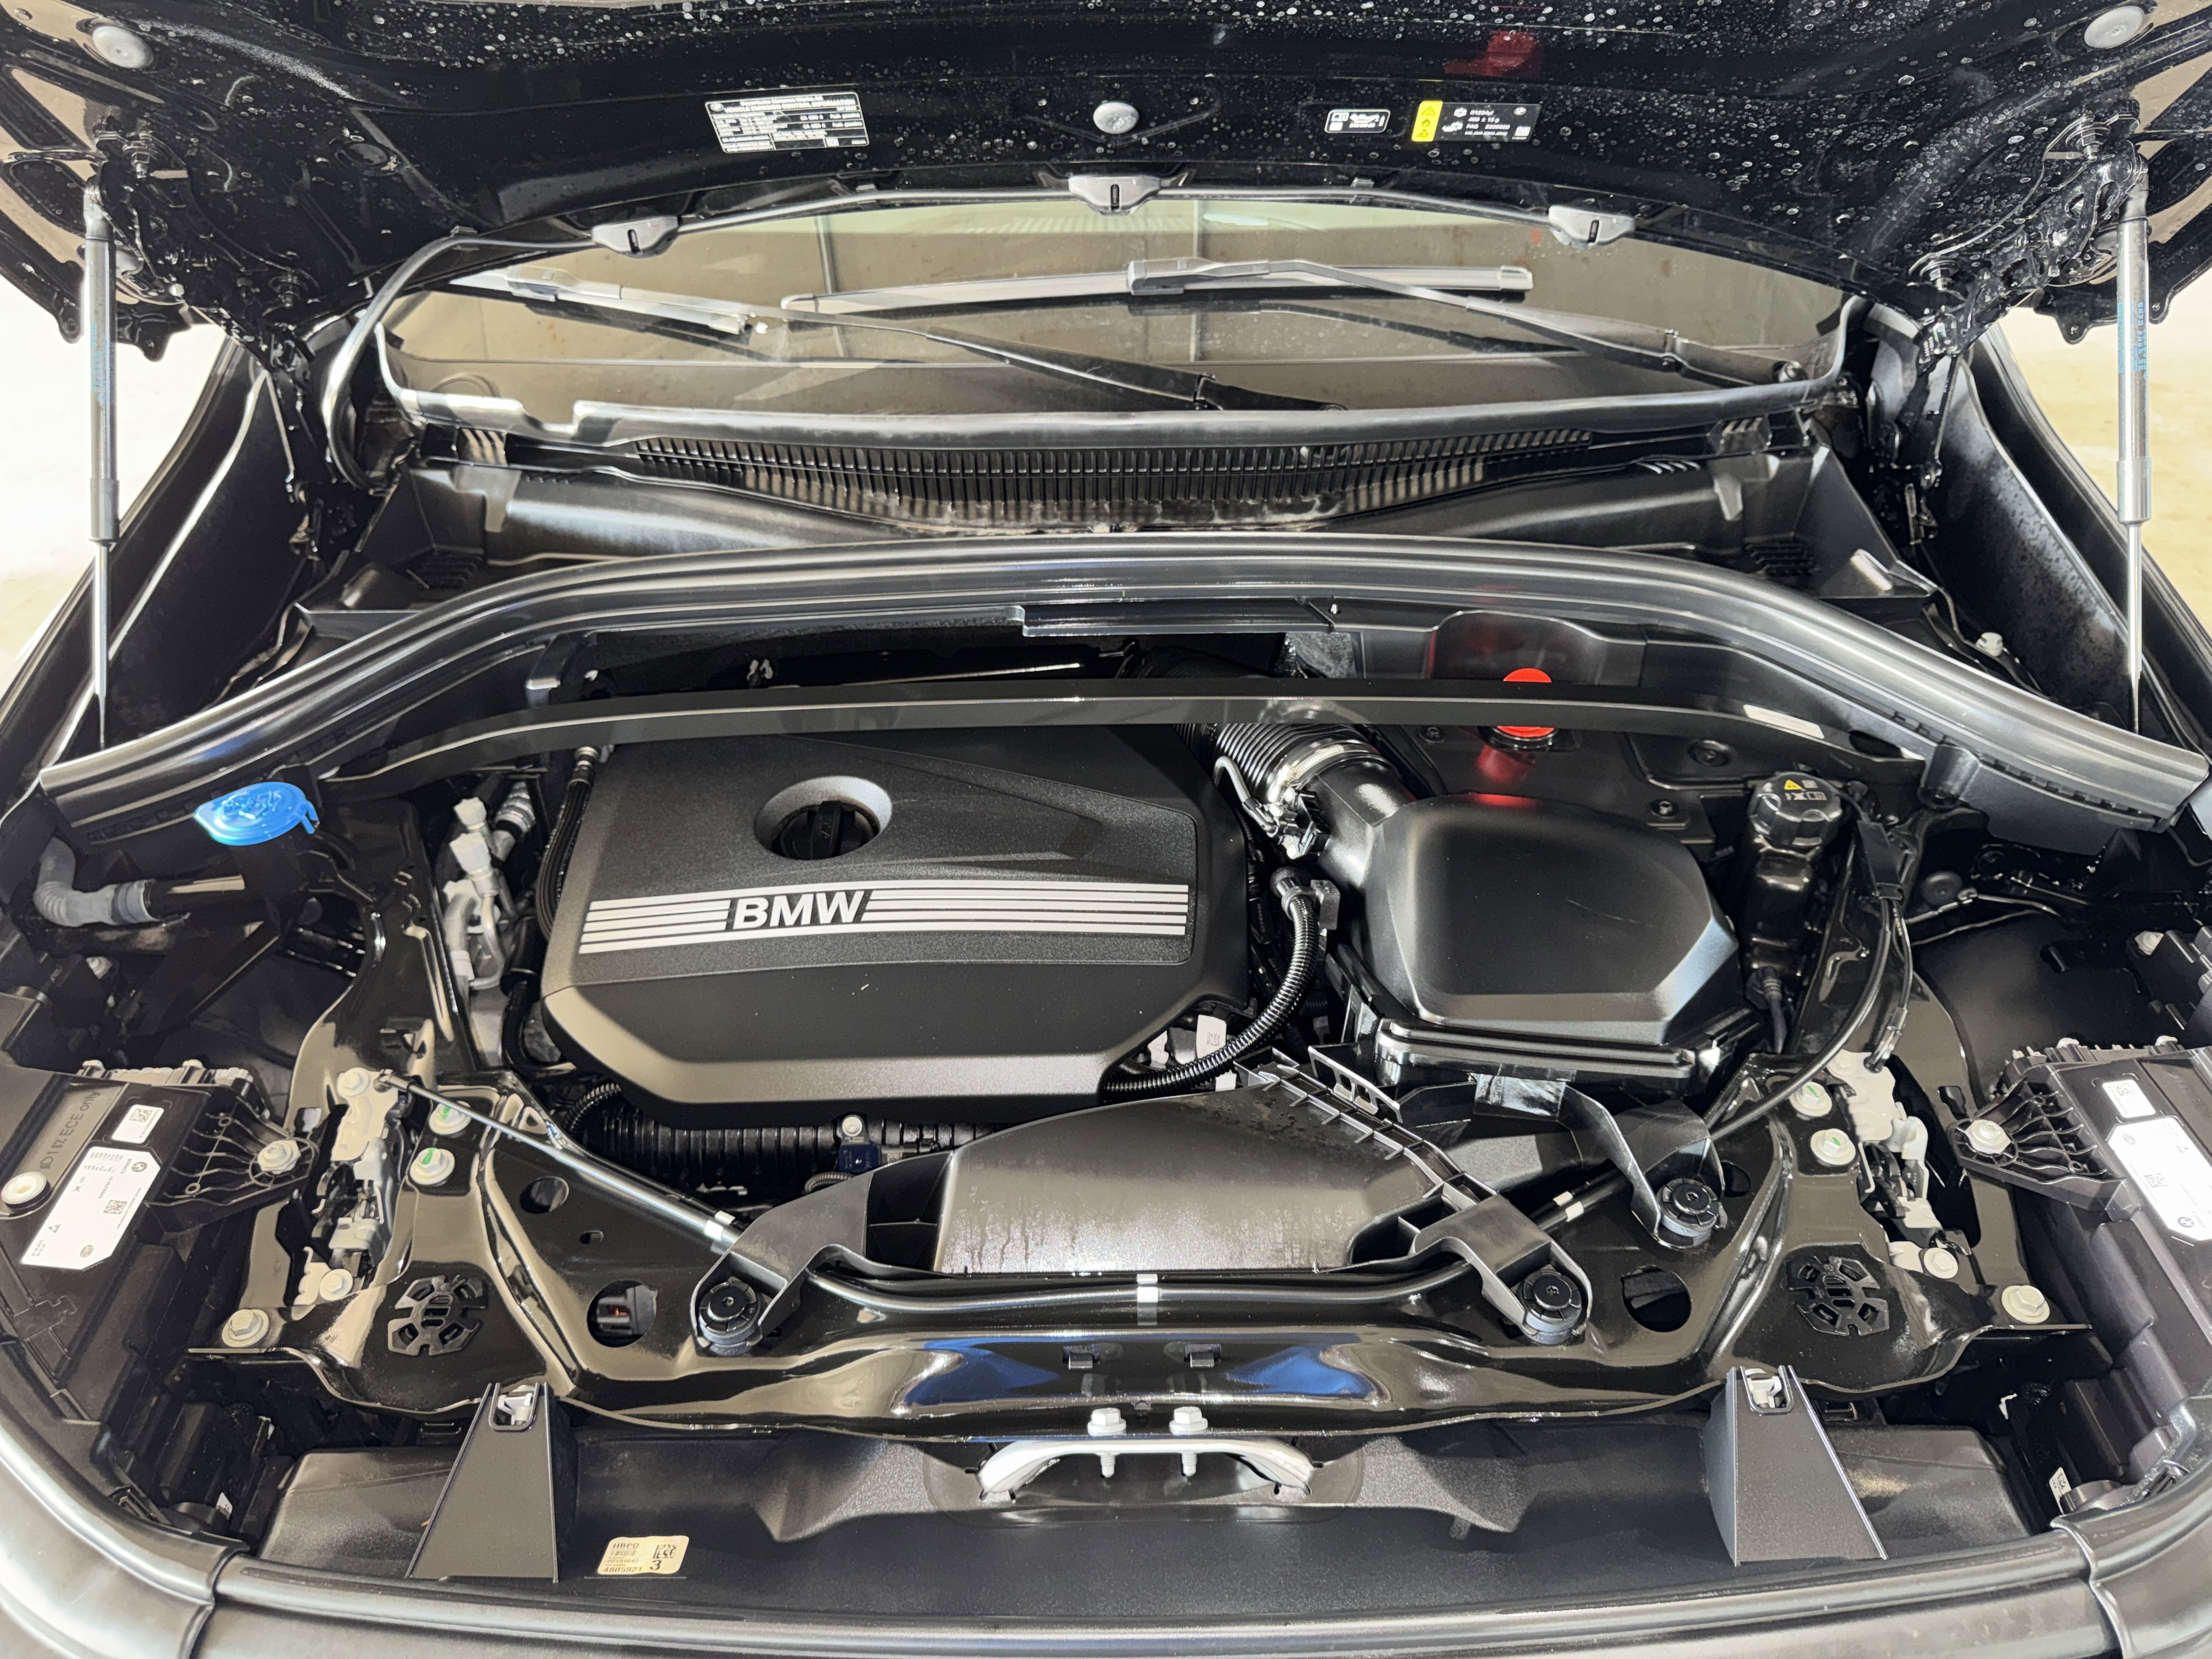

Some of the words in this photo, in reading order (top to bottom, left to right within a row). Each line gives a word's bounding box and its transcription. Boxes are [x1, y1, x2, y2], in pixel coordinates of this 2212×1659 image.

[733, 890, 865, 930] BMW
[59, 1113, 84, 1136] ECE
[80, 1091, 101, 1111] only
[650, 1560, 663, 1571] 3
